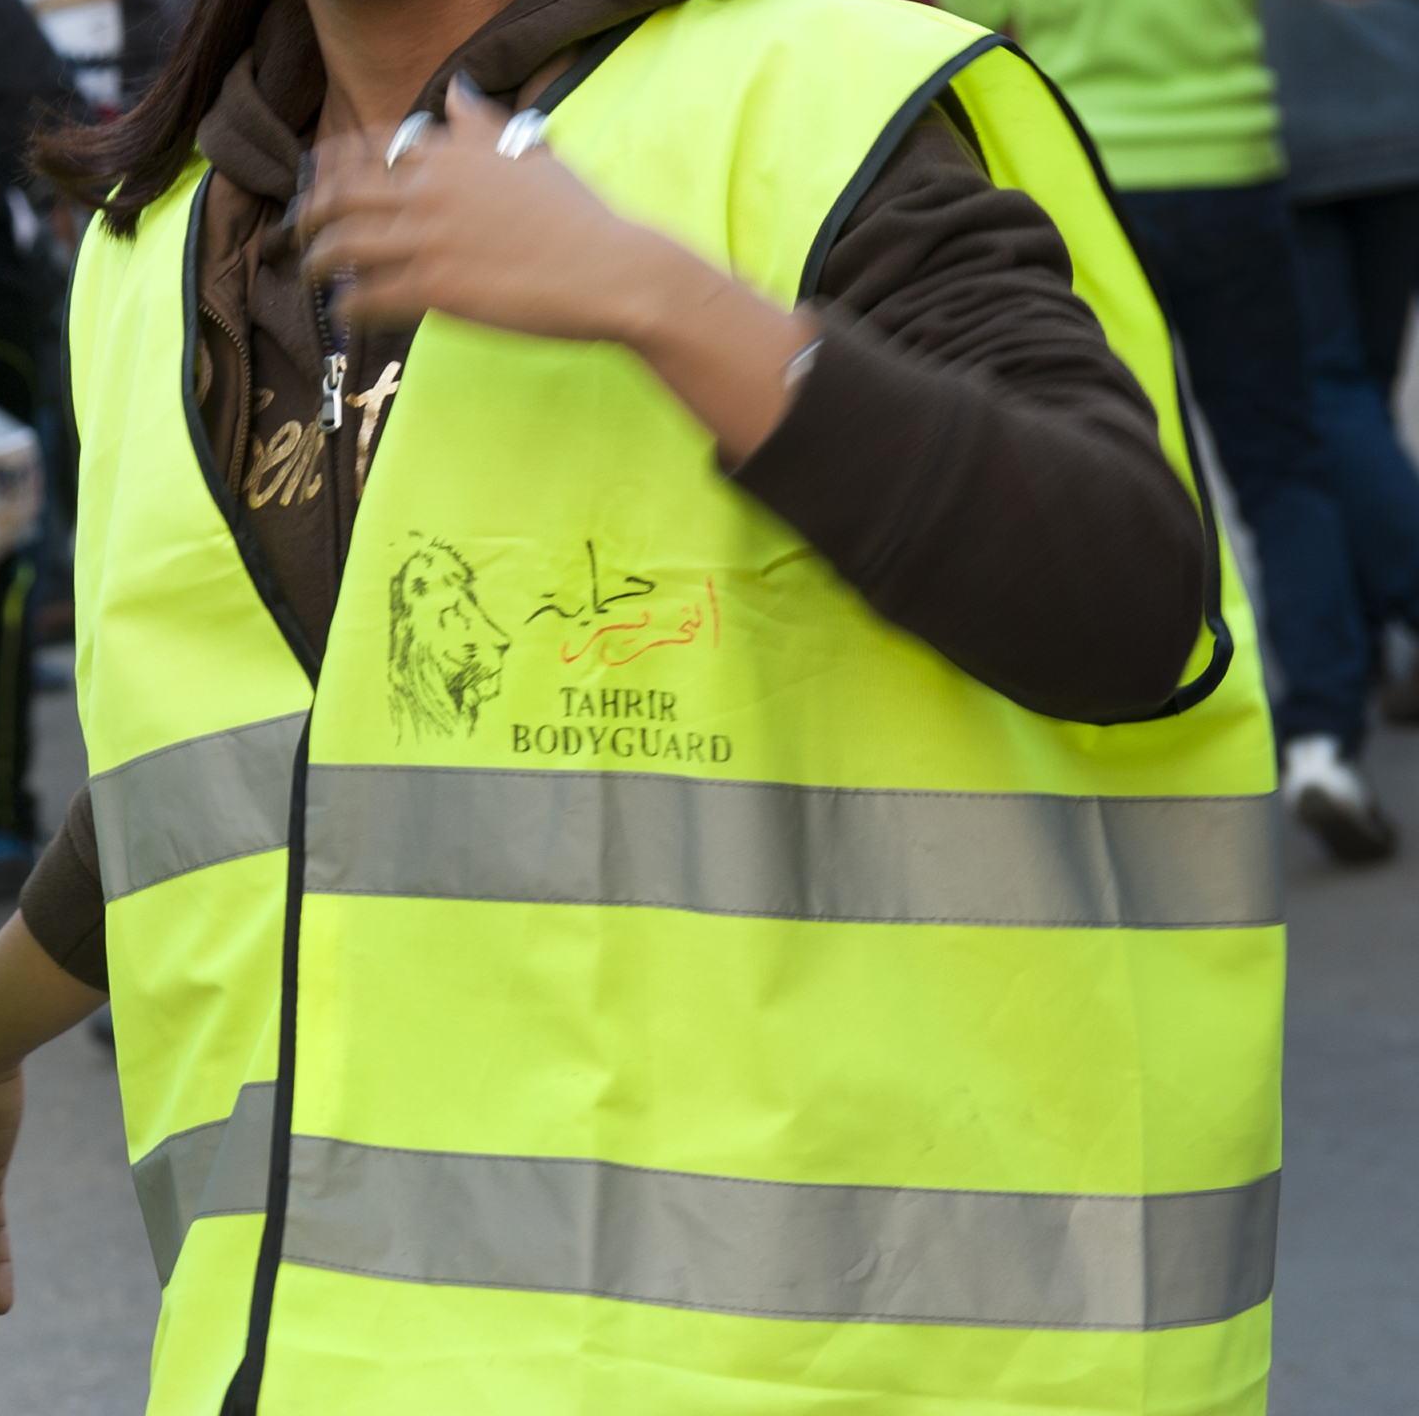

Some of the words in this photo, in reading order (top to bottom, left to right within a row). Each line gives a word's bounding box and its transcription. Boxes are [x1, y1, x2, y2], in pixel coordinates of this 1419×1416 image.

[523, 539, 657, 626] حماية
[559, 686, 679, 722] TAHRIR
[512, 724, 733, 764] BODYGUARD
